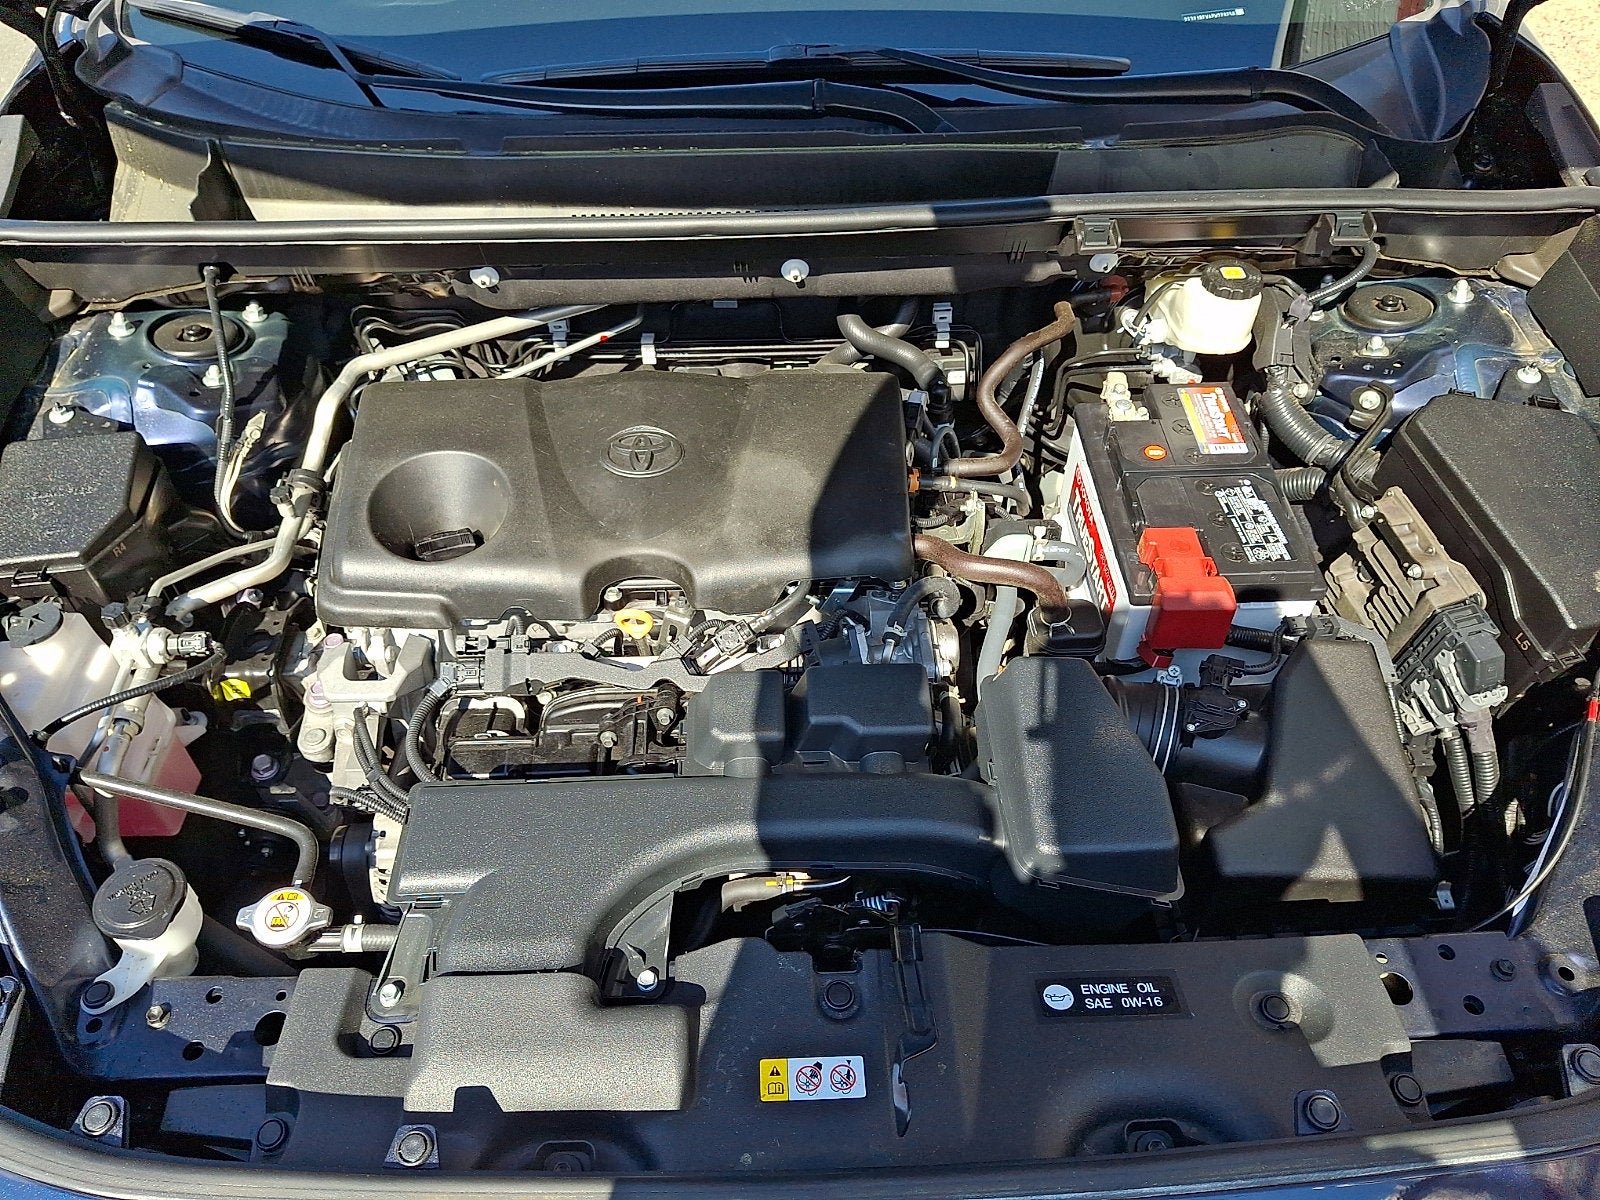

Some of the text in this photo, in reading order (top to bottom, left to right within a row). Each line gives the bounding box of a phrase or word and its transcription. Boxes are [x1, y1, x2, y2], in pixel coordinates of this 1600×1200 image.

[1514, 632, 1531, 651] L5
[1080, 982, 1160, 995] ENGINE OIL
[1085, 996, 1163, 1009] SAE 0W-16
